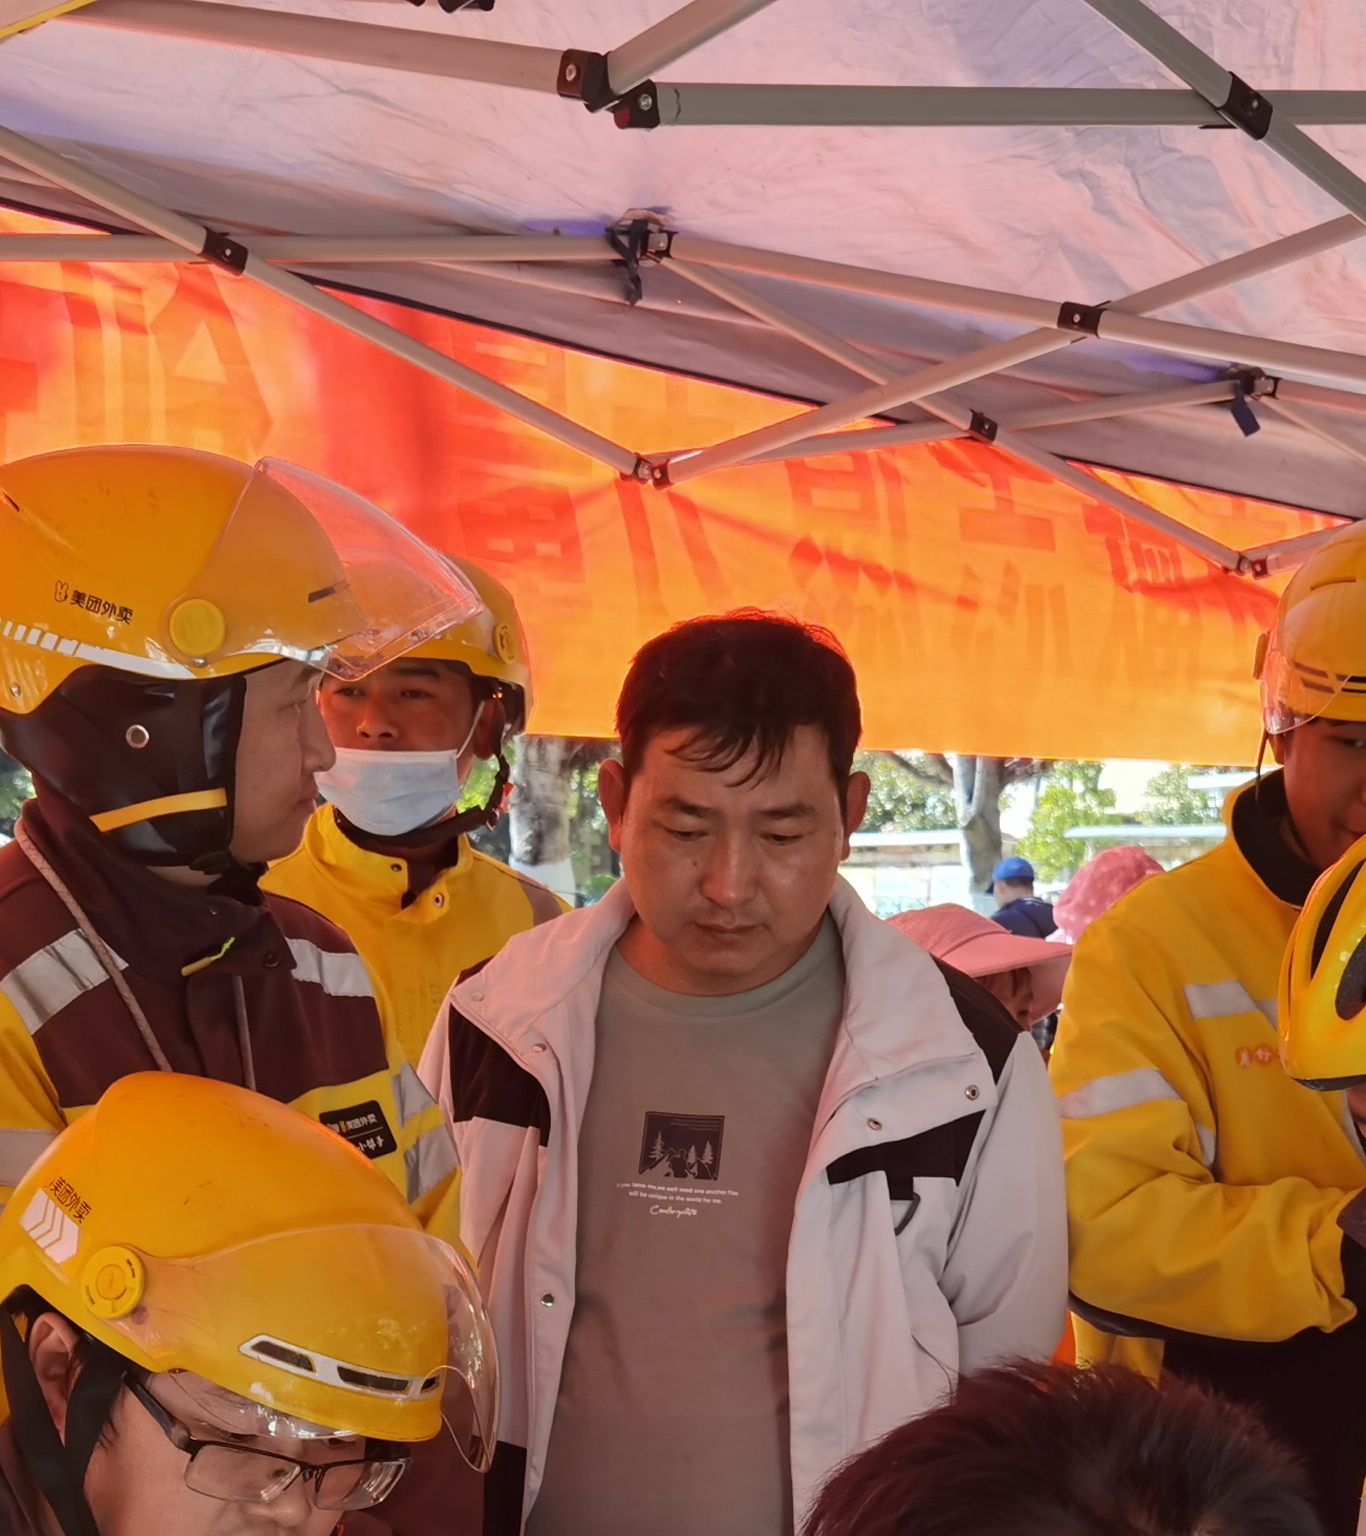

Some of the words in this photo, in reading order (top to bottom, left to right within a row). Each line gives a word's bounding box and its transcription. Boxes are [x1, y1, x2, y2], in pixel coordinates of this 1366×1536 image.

[69, 588, 134, 626] 美团外卖
[48, 1176, 93, 1225] 美团外卖
